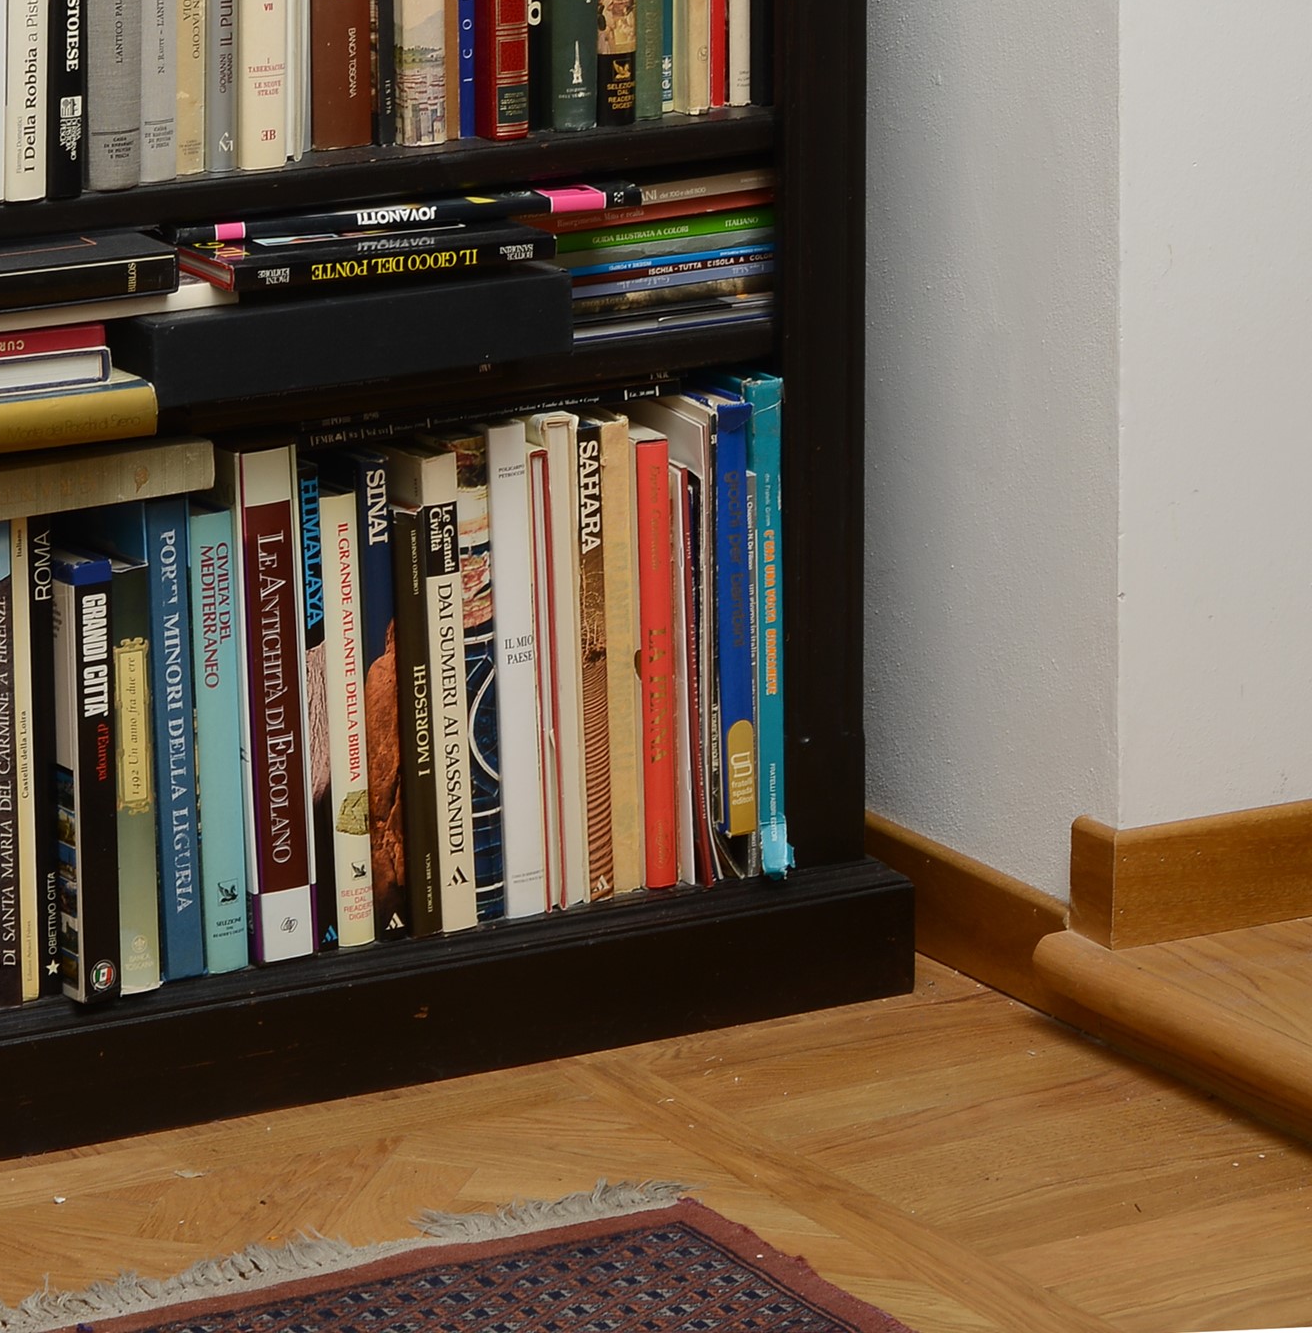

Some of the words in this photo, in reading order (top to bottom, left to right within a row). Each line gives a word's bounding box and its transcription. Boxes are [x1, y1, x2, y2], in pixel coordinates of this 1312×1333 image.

[29, 33, 37, 42] a
[220, 33, 233, 48] IL
[24, 48, 37, 105] Robbia
[24, 109, 36, 161] Della
[357, 206, 436, 226] JOVANOTTI
[311, 260, 367, 280] PONTE
[371, 257, 402, 274] DEL
[406, 253, 457, 271] GIOCO
[460, 249, 478, 266] IL
[365, 469, 388, 546] SINAI
[579, 440, 601, 554] SAHARA
[257, 530, 285, 572] LE
[301, 476, 324, 629] HIMALAYA
[338, 522, 348, 536] IL
[33, 530, 51, 602] ROMA
[338, 539, 353, 606] GRANDE
[199, 545, 220, 690] MEDITERRANEO
[437, 582, 453, 623] DAI
[219, 621, 232, 643] DEL
[341, 609, 356, 674] ATLANTE
[439, 627, 457, 708] SUMERI
[268, 709, 284, 731] DI
[346, 676, 358, 730] DELLA
[413, 664, 429, 761] MORESCHI
[444, 715, 457, 740] AI
[347, 733, 360, 782] BIBBIA
[419, 767, 429, 777] I
[268, 731, 294, 864] ERCOLANO
[443, 741, 465, 855] SASSANIDI
